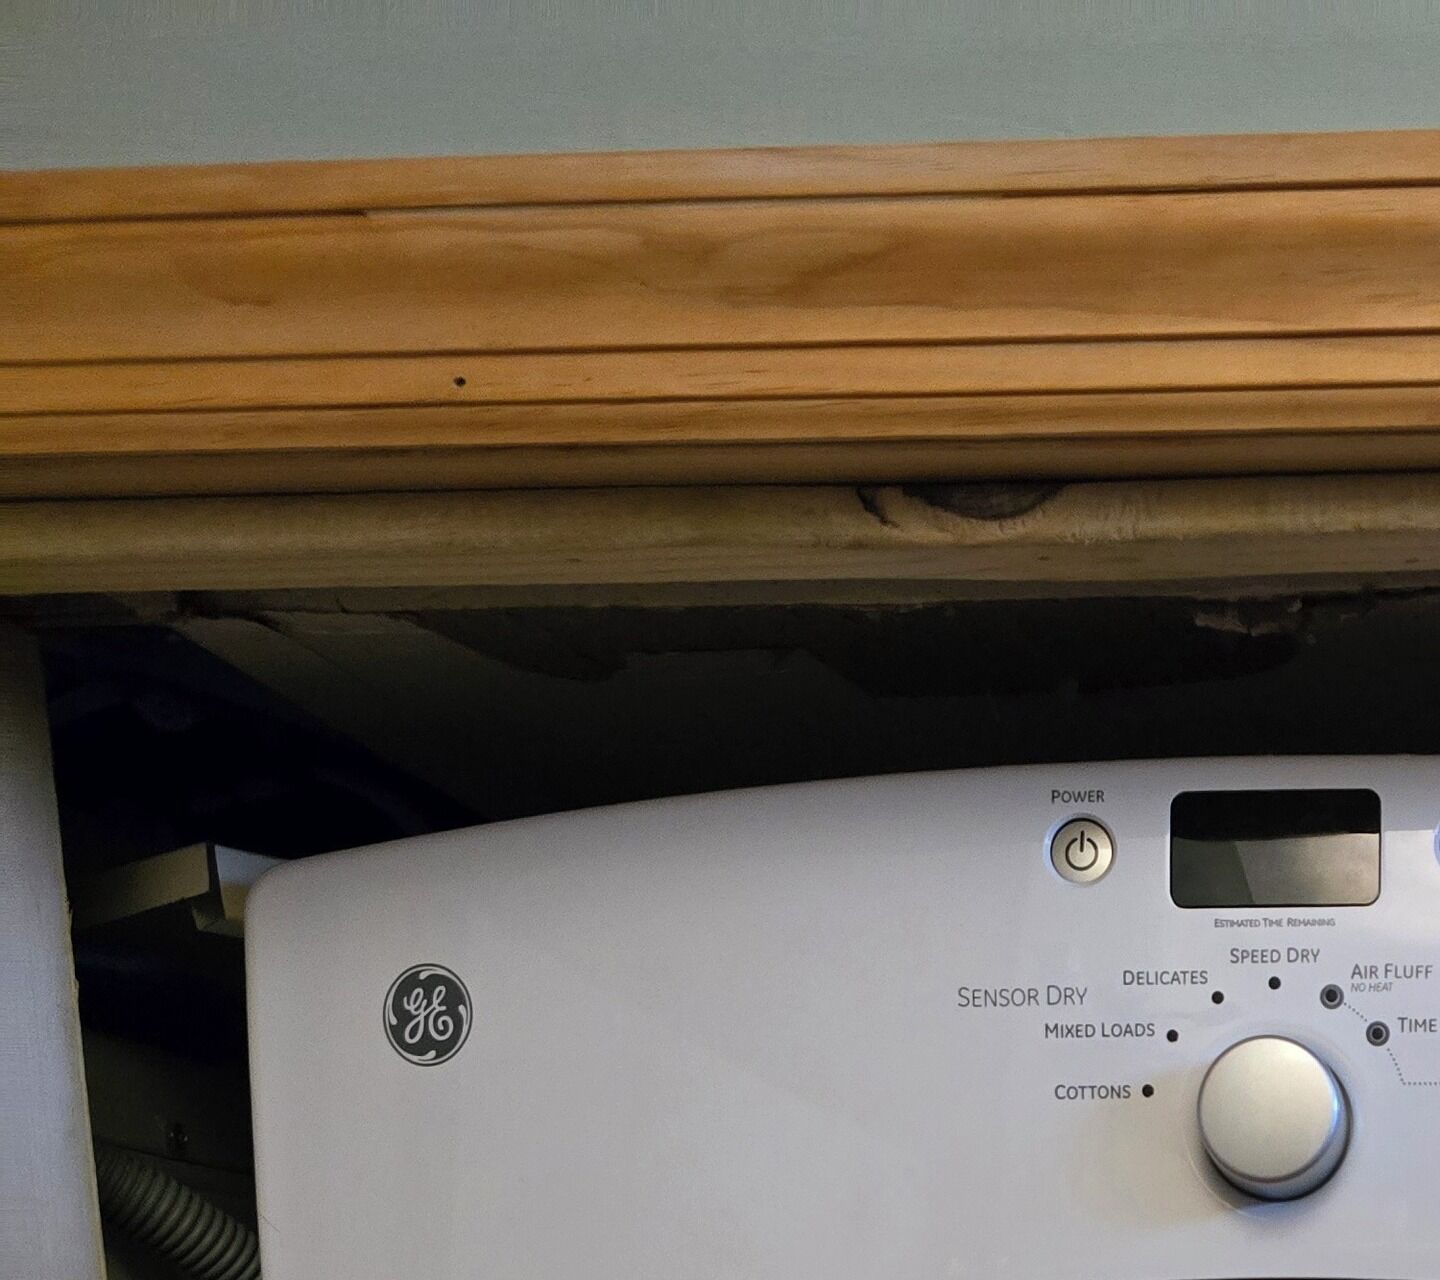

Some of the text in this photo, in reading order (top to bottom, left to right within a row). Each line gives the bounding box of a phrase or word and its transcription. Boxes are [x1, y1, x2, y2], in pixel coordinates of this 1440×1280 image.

[1050, 789, 1106, 804] POWER
[1213, 917, 1336, 929] ESTIMATED TIME REMAINING
[1229, 947, 1321, 965] SPEED DRY
[1122, 969, 1209, 986] DELICATES
[1350, 963, 1434, 980] AIR FLUFF
[1350, 981, 1394, 992] NO HEAT
[956, 983, 1089, 1008] SENSOR DRY
[1043, 1022, 1156, 1040] MIXED LOADS
[1397, 1016, 1439, 1034] TIME
[1054, 1083, 1132, 1101] COTTONS
